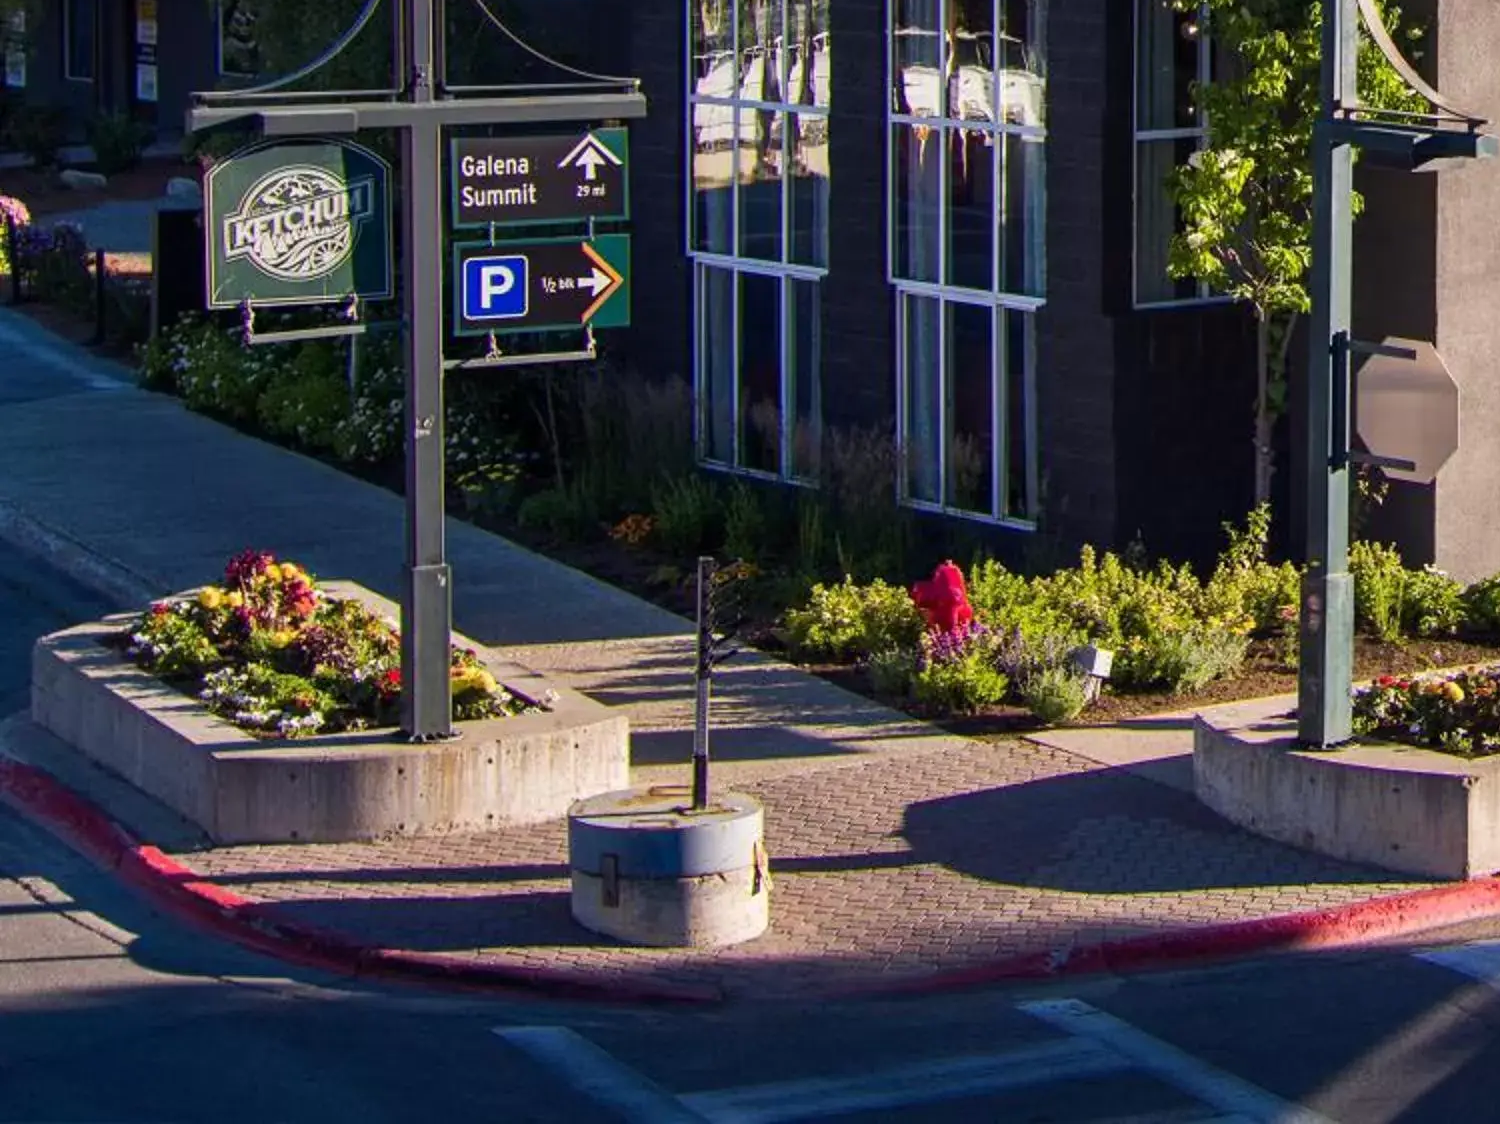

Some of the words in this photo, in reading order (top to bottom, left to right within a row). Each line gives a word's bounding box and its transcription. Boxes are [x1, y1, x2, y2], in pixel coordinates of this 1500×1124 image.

[461, 155, 529, 177] Galena
[462, 183, 537, 208] Summit
[576, 185, 590, 197] 29
[591, 184, 606, 197] mi
[235, 187, 363, 247] KETCHUM
[481, 265, 515, 309] P
